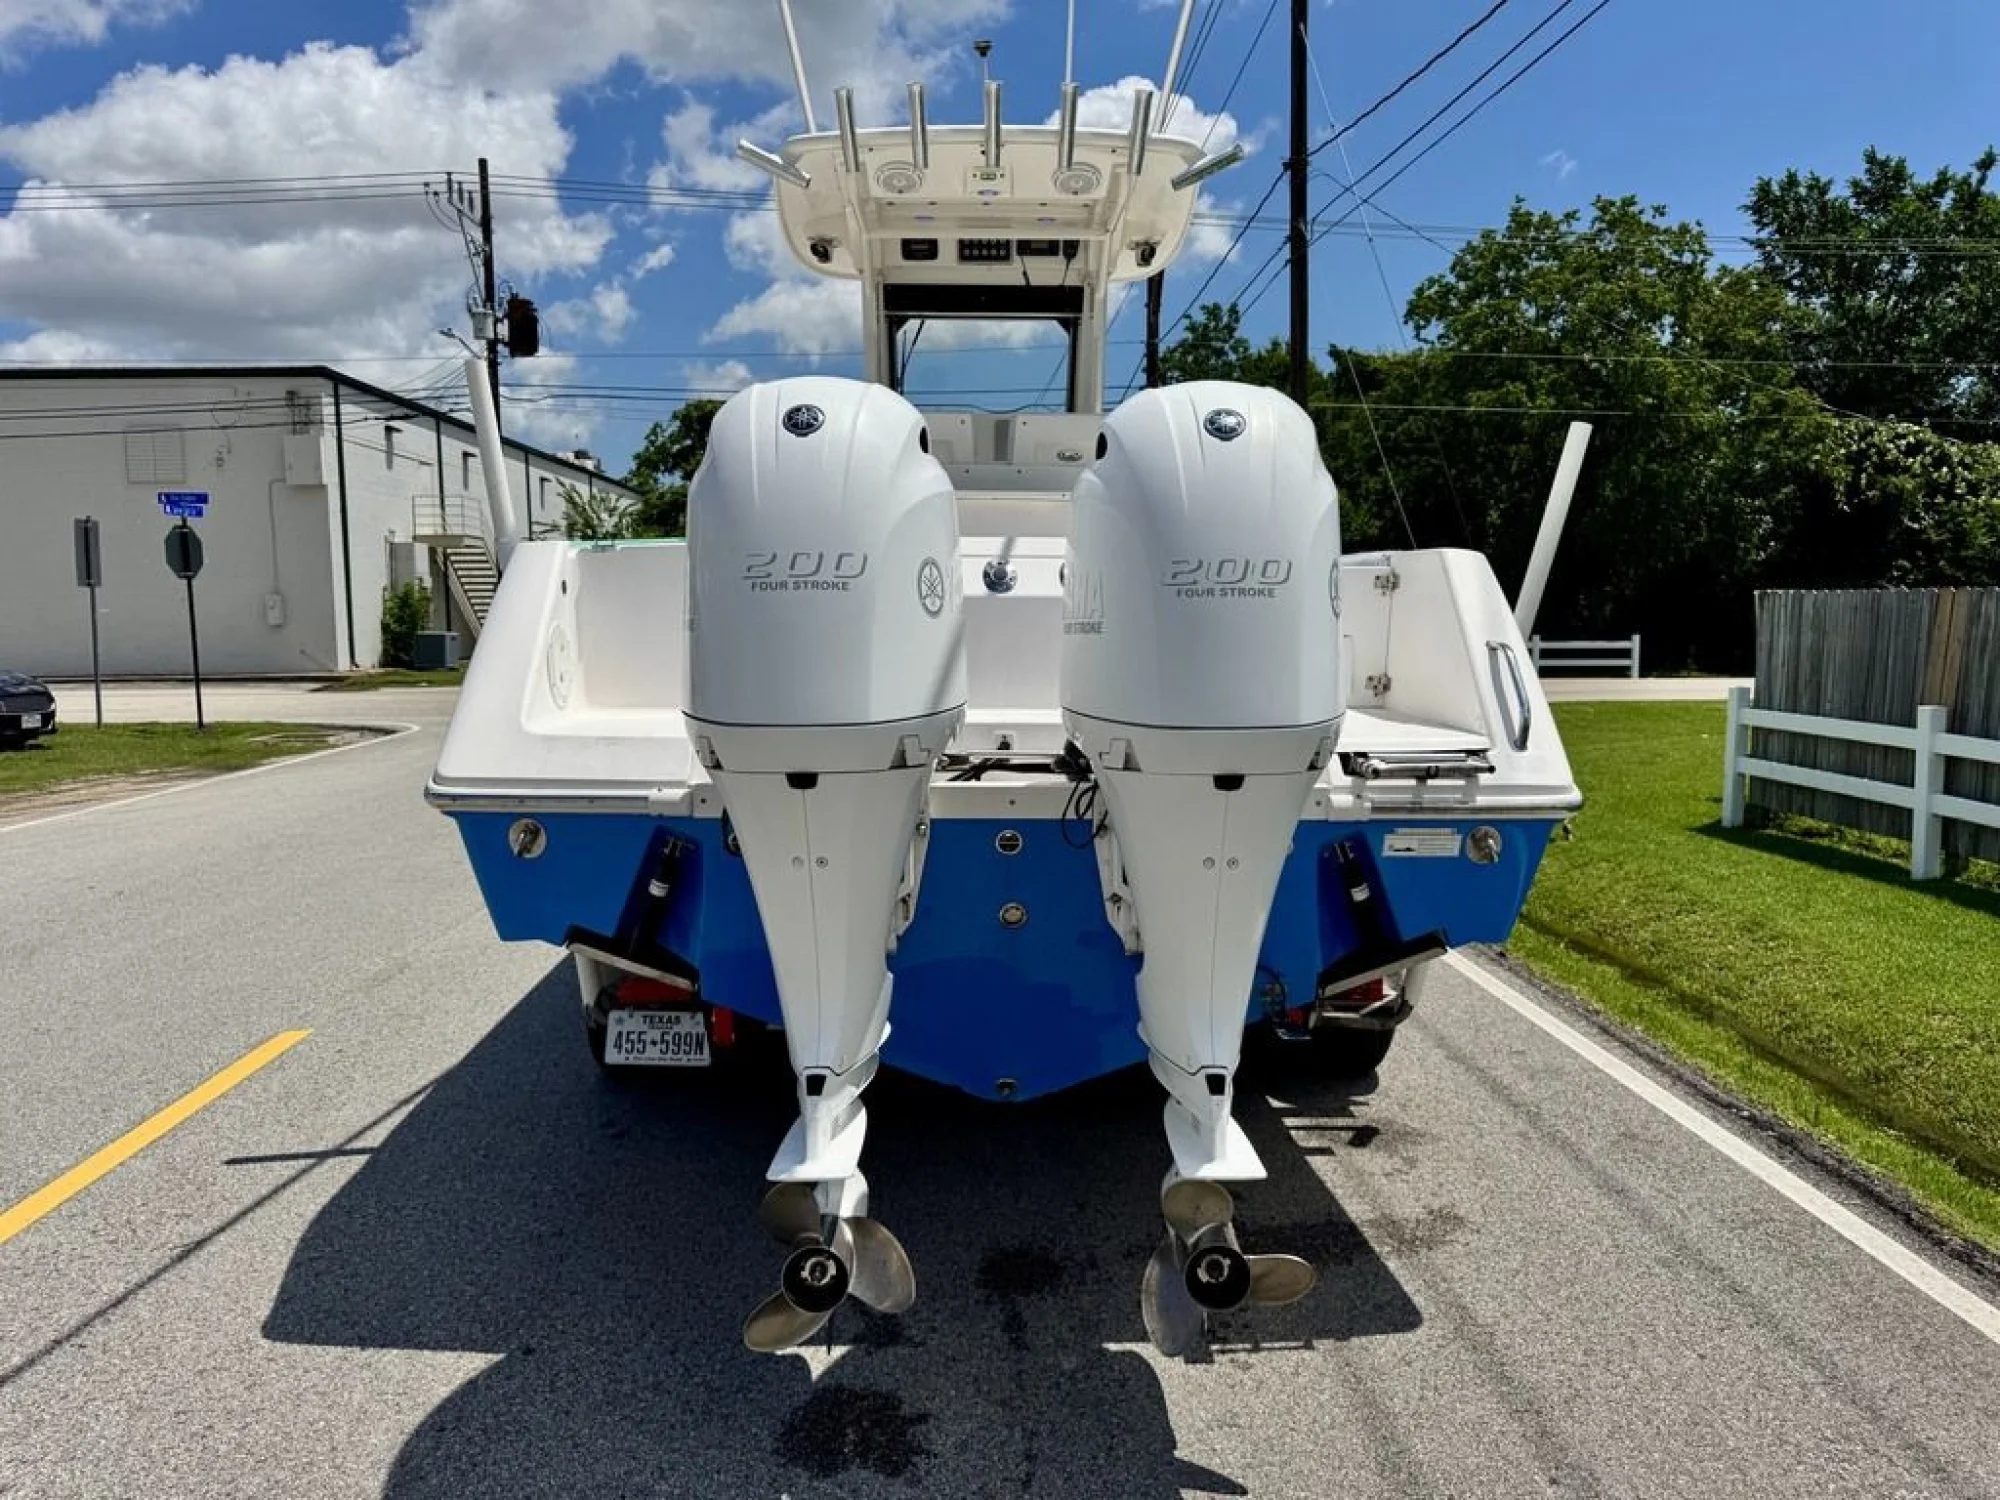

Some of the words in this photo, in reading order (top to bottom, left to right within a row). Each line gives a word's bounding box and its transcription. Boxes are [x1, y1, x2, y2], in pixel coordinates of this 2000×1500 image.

[741, 551, 868, 579] 200
[1162, 558, 1293, 586] 200
[751, 581, 788, 591] FOUR
[792, 580, 852, 591] STROKE
[1176, 587, 1216, 598] FOUR
[1219, 587, 1278, 598] STROKE
[641, 1015, 682, 1025] TEXAS
